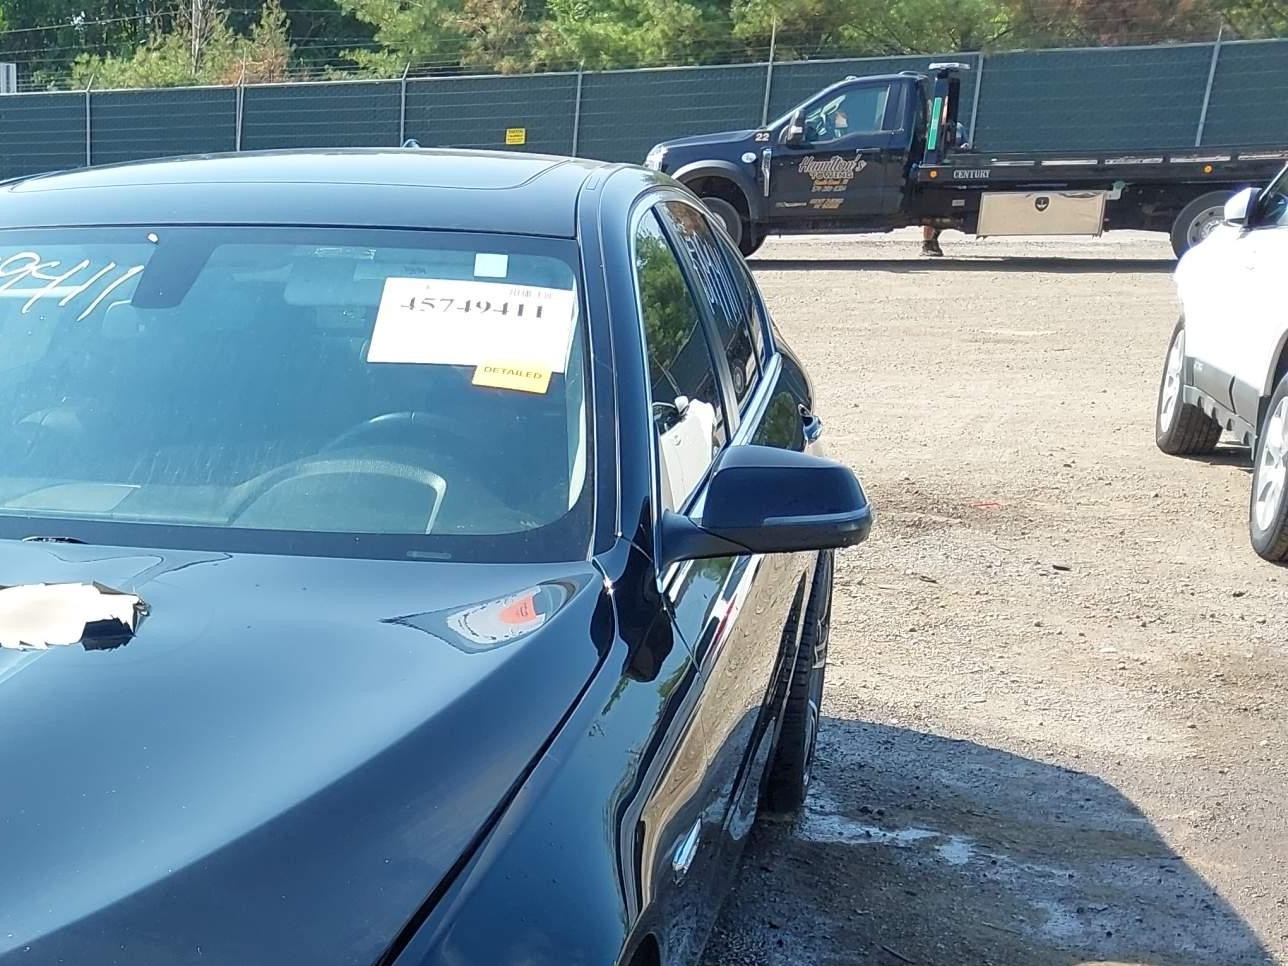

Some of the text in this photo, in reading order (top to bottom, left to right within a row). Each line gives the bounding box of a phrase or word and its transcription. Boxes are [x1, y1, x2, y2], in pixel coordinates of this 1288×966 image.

[755, 133, 770, 141] 22
[811, 171, 854, 179] TOWING
[953, 169, 991, 179] CENTURY
[400, 296, 543, 319] 45749411
[483, 365, 543, 380] DETAILED
